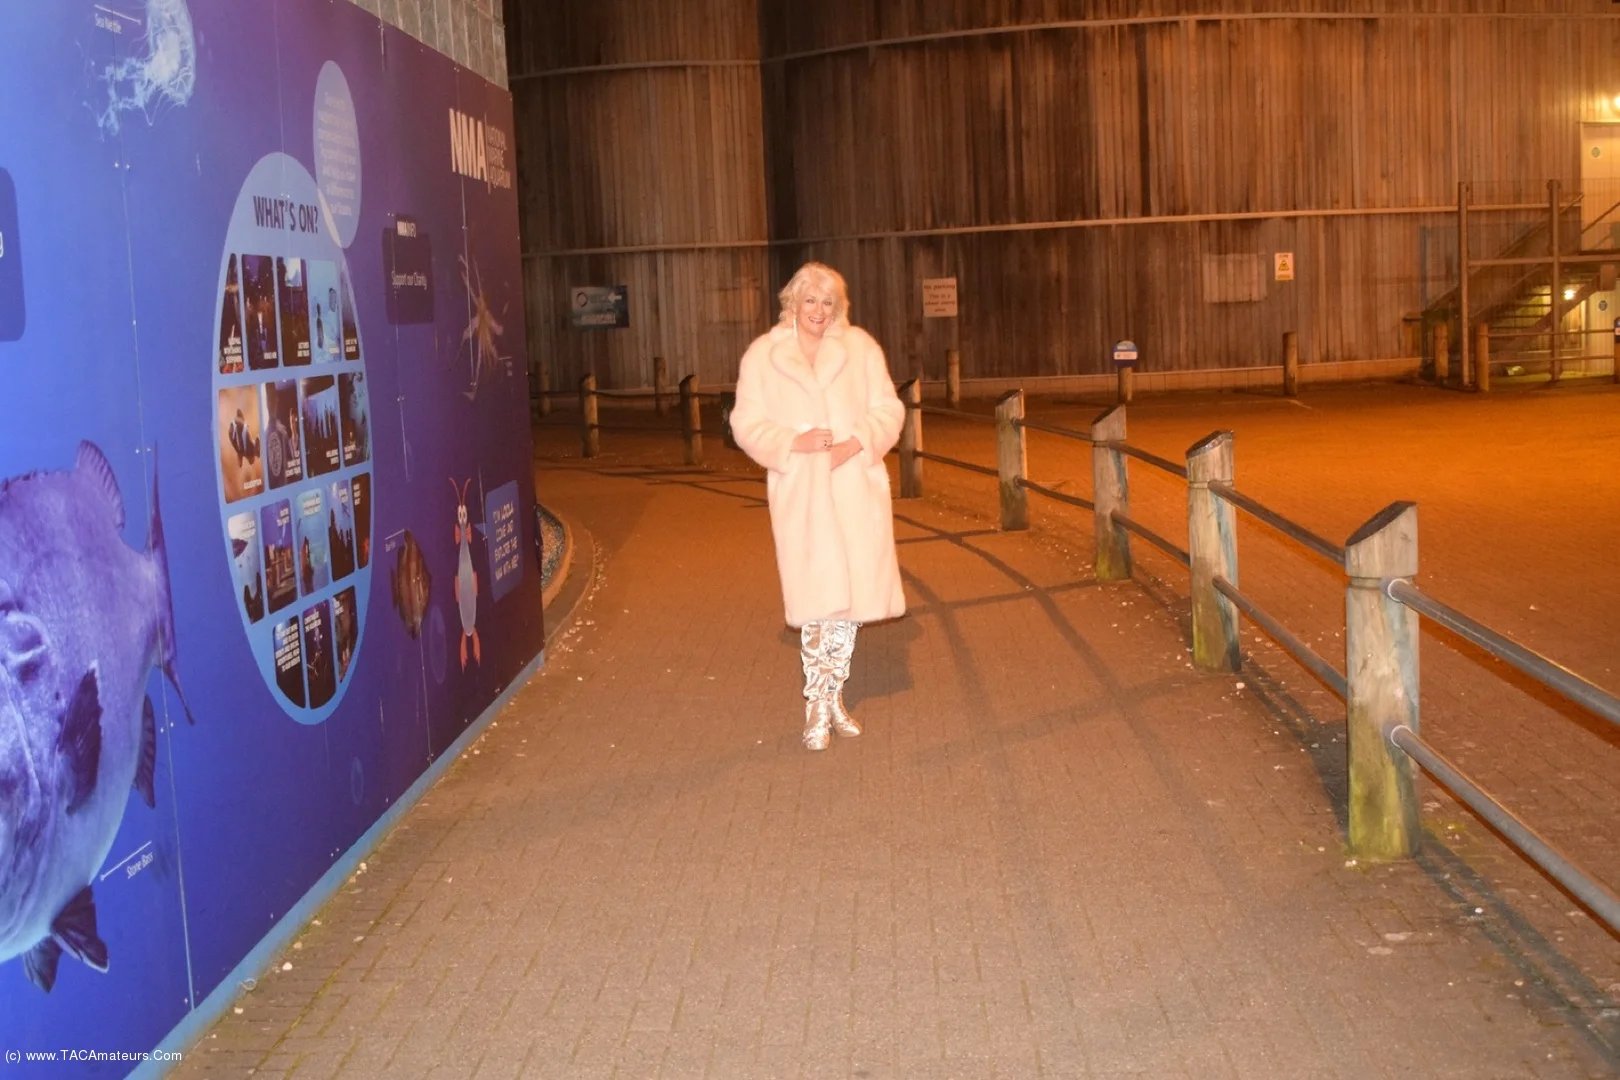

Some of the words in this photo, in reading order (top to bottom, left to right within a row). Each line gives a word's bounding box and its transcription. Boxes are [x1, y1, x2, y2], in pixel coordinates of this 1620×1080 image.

[449, 108, 487, 182] NMA
[253, 196, 296, 232] WHAT'S
[299, 203, 319, 234] ON?
[391, 270, 406, 288] Support
[414, 272, 428, 290] Charity
[127, 861, 142, 879] Stone
[142, 852, 154, 868] Bass
